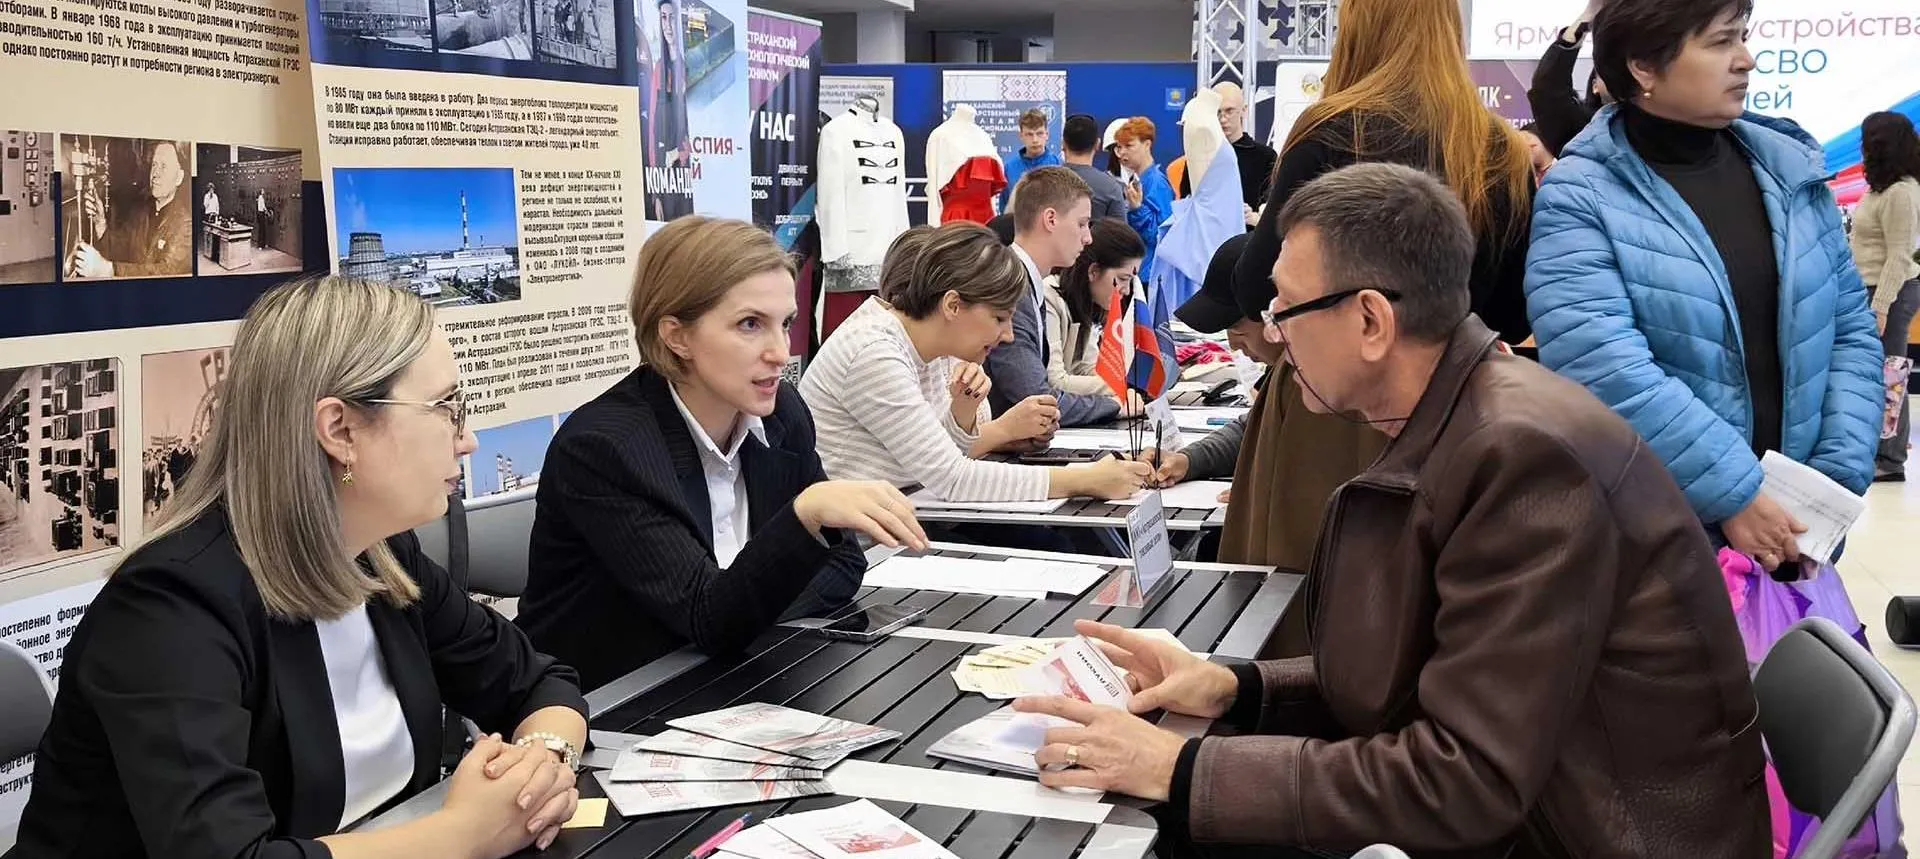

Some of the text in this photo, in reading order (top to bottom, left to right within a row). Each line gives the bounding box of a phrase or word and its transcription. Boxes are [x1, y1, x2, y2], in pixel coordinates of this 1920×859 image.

[214, 0, 276, 19] разворачивается
[50, 6, 57, 19] В
[62, 10, 94, 26] январе
[98, 14, 120, 29] 1968
[124, 19, 144, 33] года
[148, 23, 153, 33] в
[157, 24, 212, 42] эксплуатацию
[215, 33, 262, 49] принимается
[265, 41, 299, 55] последний
[129, 2, 299, 40] котлы высокого давления и турбогенераторы
[86, 31, 103, 45] 160
[107, 34, 122, 48] т/ч.
[126, 35, 188, 56] Установленная
[191, 47, 230, 62] мощность
[232, 50, 280, 70] Астраханской
[282, 57, 300, 71] ГРЭС
[1754, 48, 1828, 74] СВО
[2, 42, 280, 85] однако постоянно растут и потребности региона в электроэнергии.
[324, 85, 329, 97] В
[348, 89, 364, 101] году
[366, 90, 382, 99] она
[384, 89, 406, 100] была
[408, 92, 438, 103] введена
[440, 94, 446, 102] в
[476, 93, 488, 105] Два
[509, 97, 546, 108] энергоблока
[589, 103, 618, 112] мощностью
[1745, 84, 1792, 110] ей
[344, 102, 358, 114] МВт
[360, 104, 393, 116] каждый
[395, 106, 427, 117] приняли
[428, 108, 433, 116] в
[434, 108, 484, 119] эксплуатацию
[486, 110, 490, 118] в
[521, 112, 525, 120] а
[526, 112, 530, 120] в
[566, 114, 583, 124] годах
[335, 119, 354, 129] ввели
[355, 120, 370, 131] еще
[373, 121, 388, 131] два
[390, 119, 414, 130] блока
[415, 122, 424, 131] по
[426, 120, 439, 131] 110
[459, 121, 486, 133] Сегодня
[487, 122, 525, 134] Астраханская
[525, 124, 544, 136] ТЭЦ-2
[759, 110, 796, 142] НАС
[328, 133, 353, 146] Станция
[354, 136, 390, 146] исправно
[392, 134, 429, 147] работает,
[430, 135, 476, 146] обеспечивая
[524, 138, 548, 148] жителей
[569, 141, 580, 150] уже
[690, 135, 733, 155] СПИЯ
[520, 169, 532, 179] Тем
[444, 318, 495, 332] стремительное
[497, 312, 544, 326] реформирование
[472, 334, 477, 343] в
[480, 331, 500, 342] состав
[467, 345, 508, 358] Астраханской
[458, 362, 472, 373] 110
[467, 372, 510, 386] эксплуатацию
